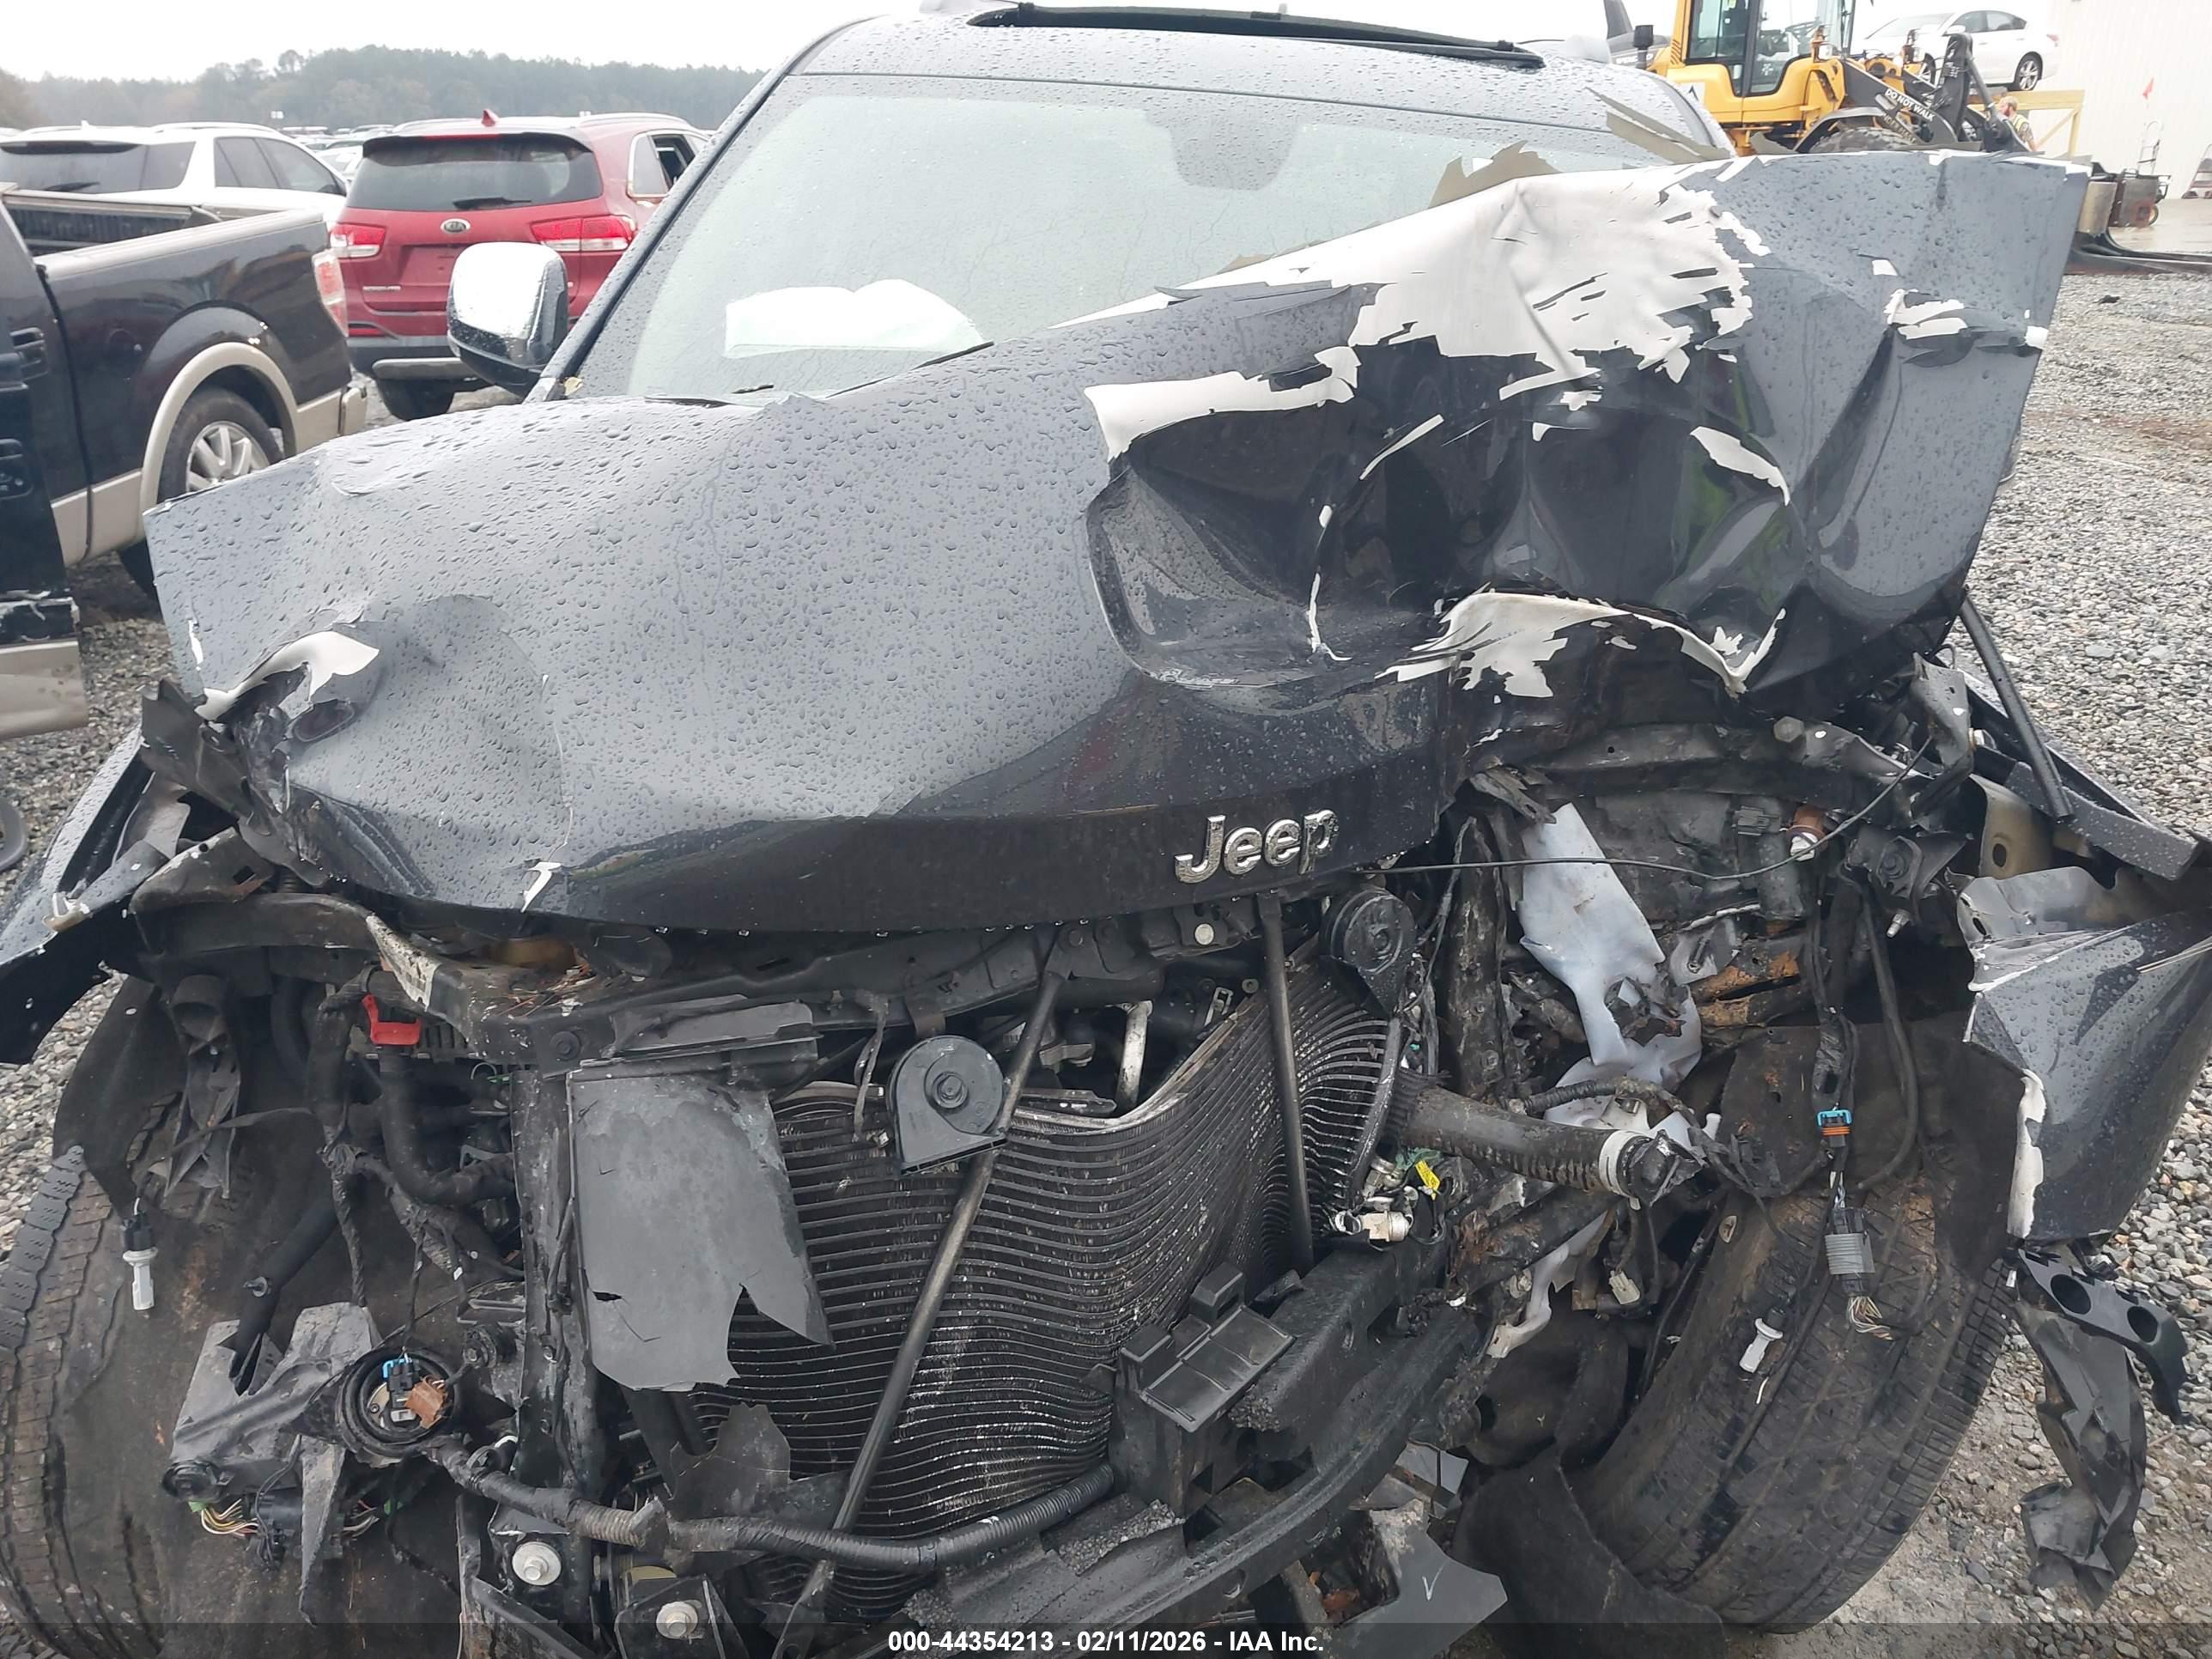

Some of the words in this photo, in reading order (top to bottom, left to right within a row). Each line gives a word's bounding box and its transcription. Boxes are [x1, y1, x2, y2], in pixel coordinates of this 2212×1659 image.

[1884, 88, 1898, 100] DO
[1897, 94, 1914, 109] NOT
[1913, 104, 1936, 121] WALK
[1174, 809, 1340, 884] Jeep
